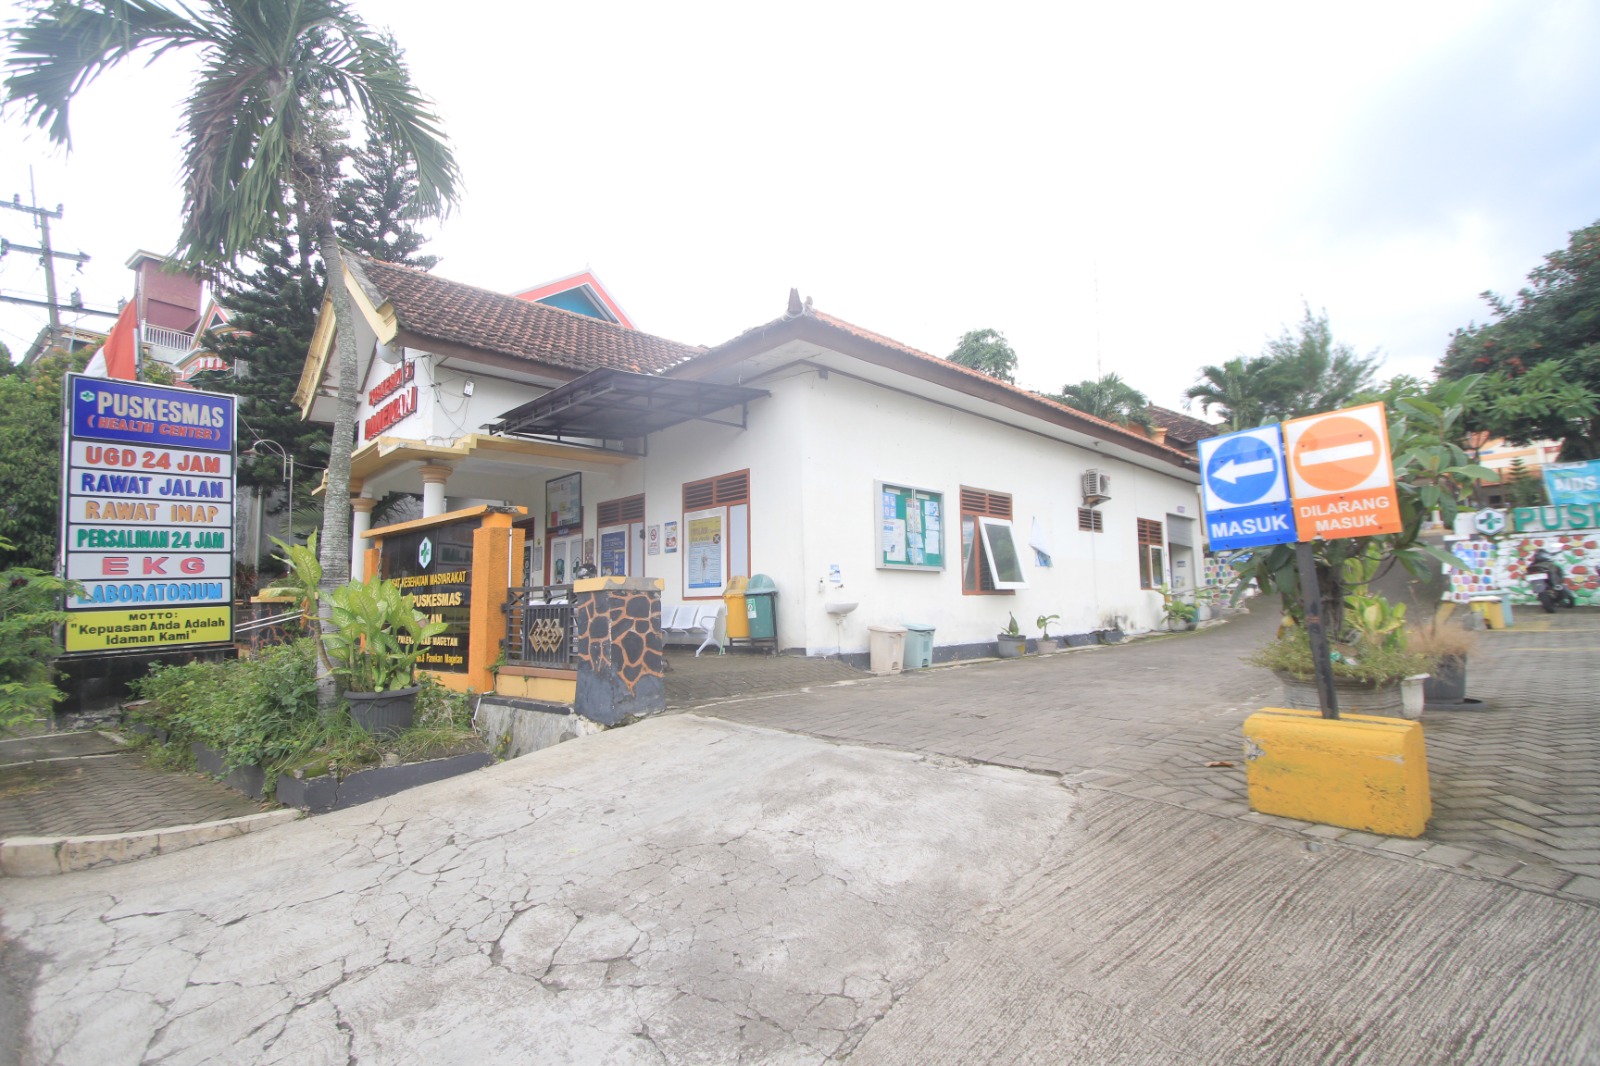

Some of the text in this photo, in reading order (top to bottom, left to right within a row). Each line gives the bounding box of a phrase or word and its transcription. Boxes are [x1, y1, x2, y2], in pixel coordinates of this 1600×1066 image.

[98, 391, 224, 428] PUSKESMAS
[86, 446, 221, 474] UGD 24 JAM
[81, 473, 224, 498] RAWAT JALAN
[85, 501, 219, 523] RAWAT INAP
[1301, 496, 1390, 519] DILARANG
[1211, 514, 1289, 539] MASUK
[1315, 514, 1378, 533] MASUK
[77, 529, 225, 549] PERSALINAN 24 JAM
[101, 556, 206, 576] EKG
[129, 612, 178, 621] MOTTO:
[150, 621, 181, 631] Anda
[185, 617, 225, 629] Adalah
[106, 633, 155, 645] Idaman
